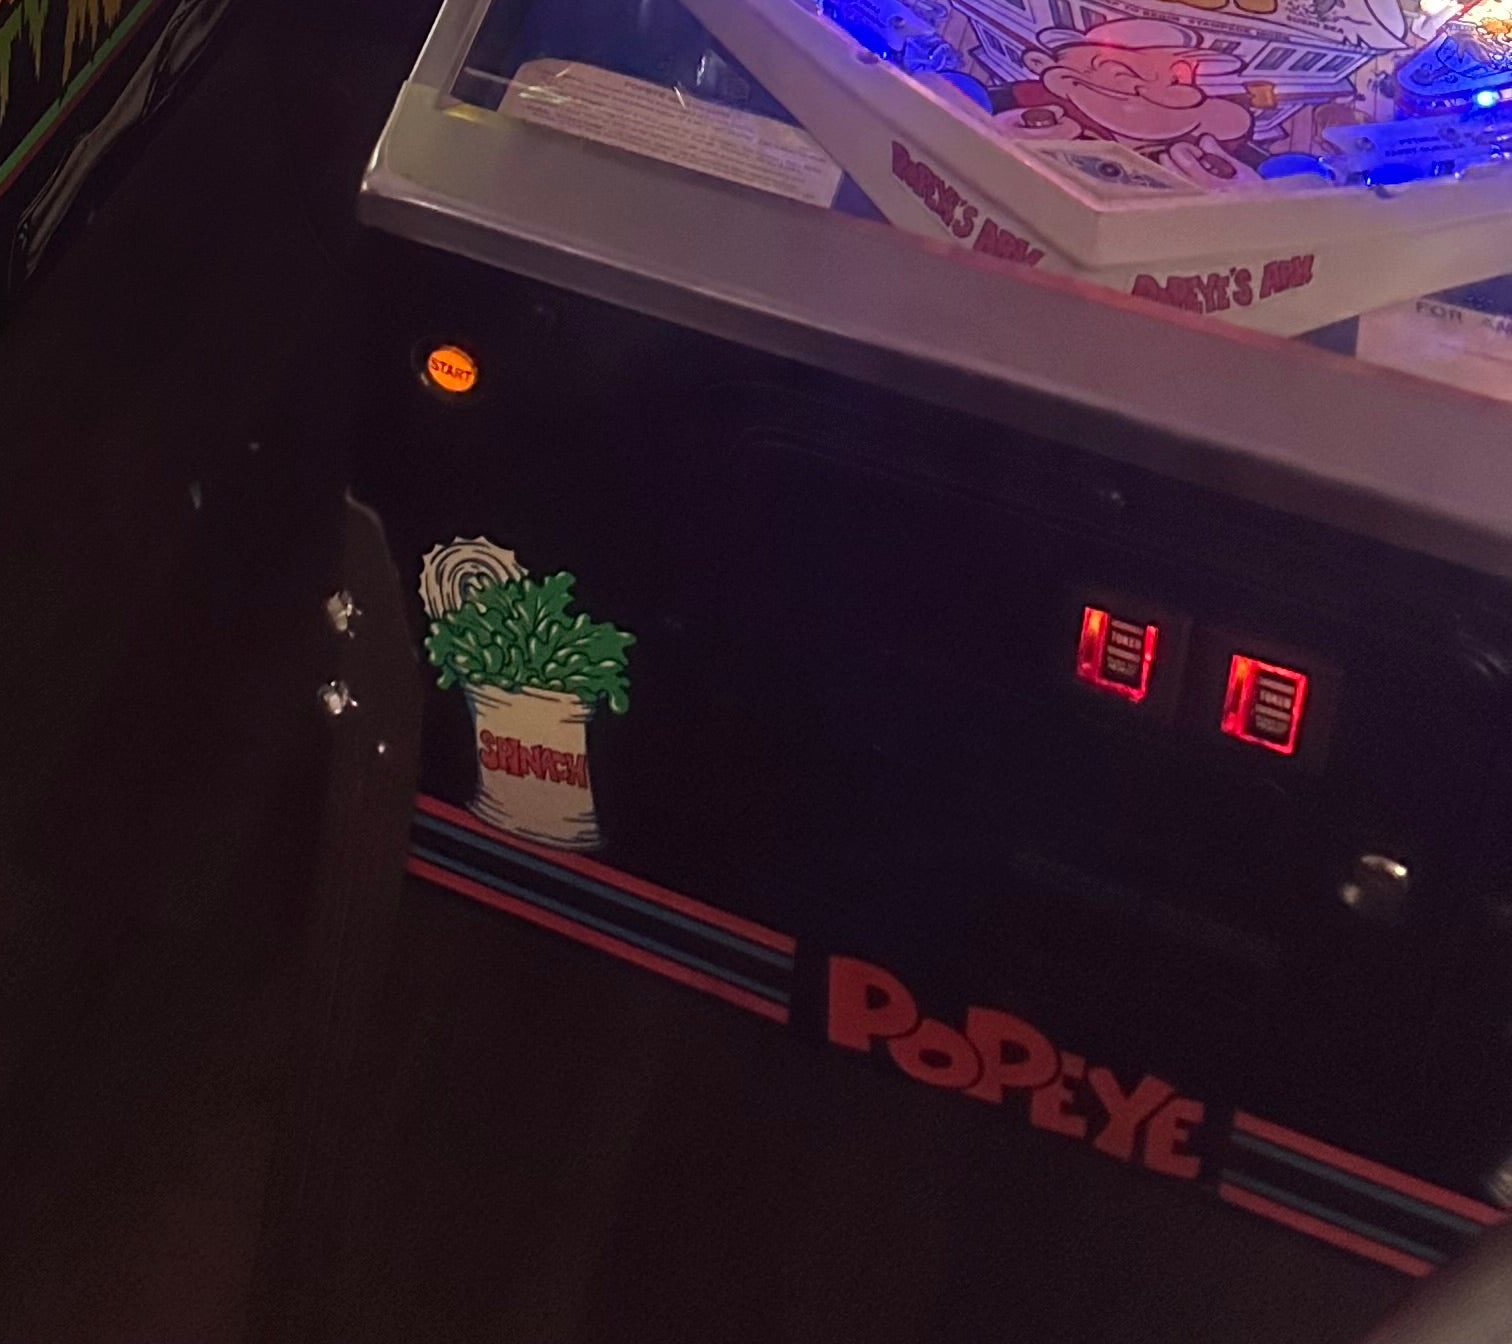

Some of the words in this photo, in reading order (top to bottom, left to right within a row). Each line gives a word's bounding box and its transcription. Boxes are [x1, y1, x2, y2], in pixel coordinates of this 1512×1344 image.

[1415, 300, 1463, 324] FOR
[429, 356, 473, 384] START
[478, 727, 589, 790] SPINACH
[826, 954, 1205, 1180] POPEYE
